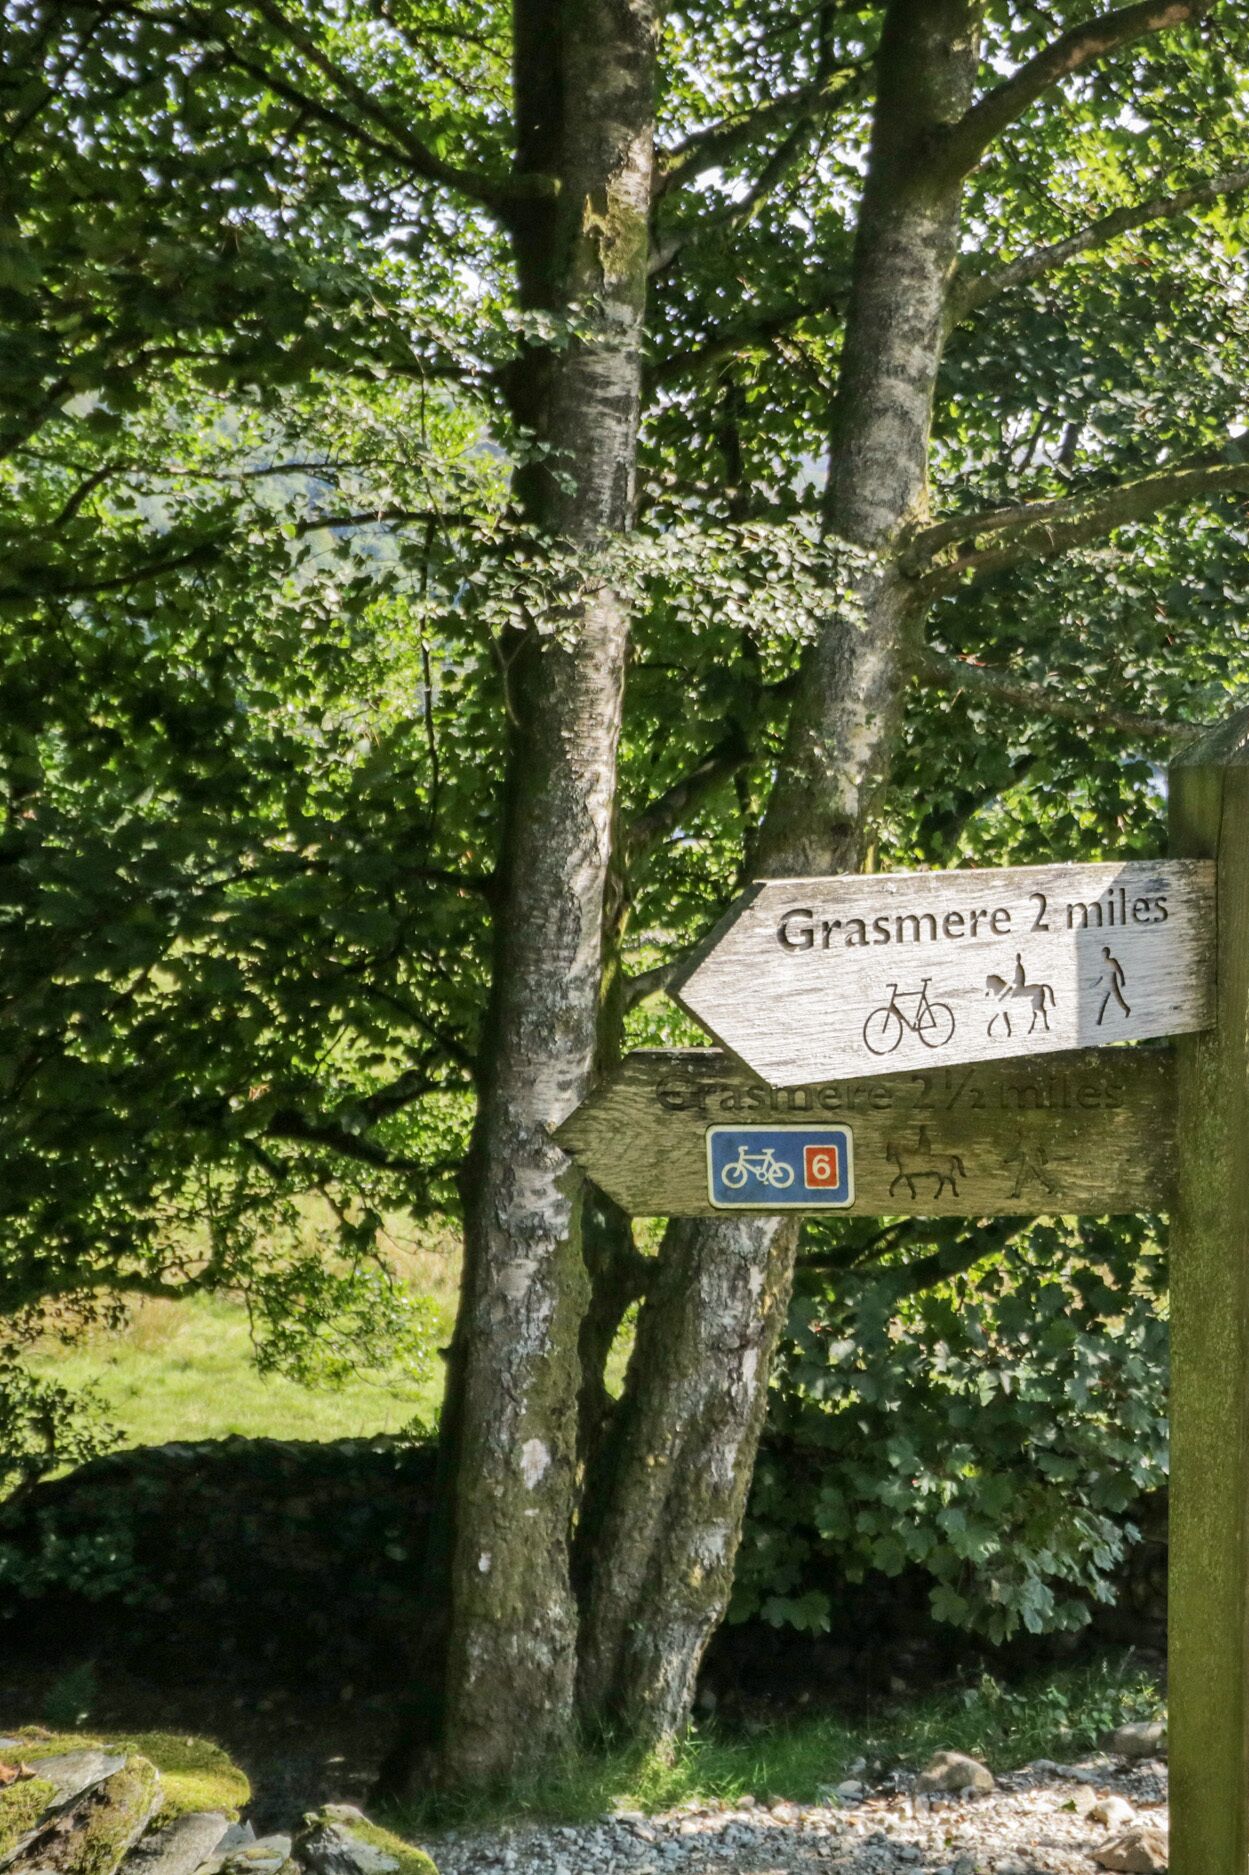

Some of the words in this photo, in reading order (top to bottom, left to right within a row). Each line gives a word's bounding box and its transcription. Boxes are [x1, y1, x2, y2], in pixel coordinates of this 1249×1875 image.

[776, 907, 1012, 953] Grasmere
[1029, 892, 1050, 933] 2
[1066, 887, 1169, 930] miles
[656, 1074, 893, 1113] Grasmere
[1001, 1071, 1125, 1110] miles
[811, 1155, 831, 1181] 6
